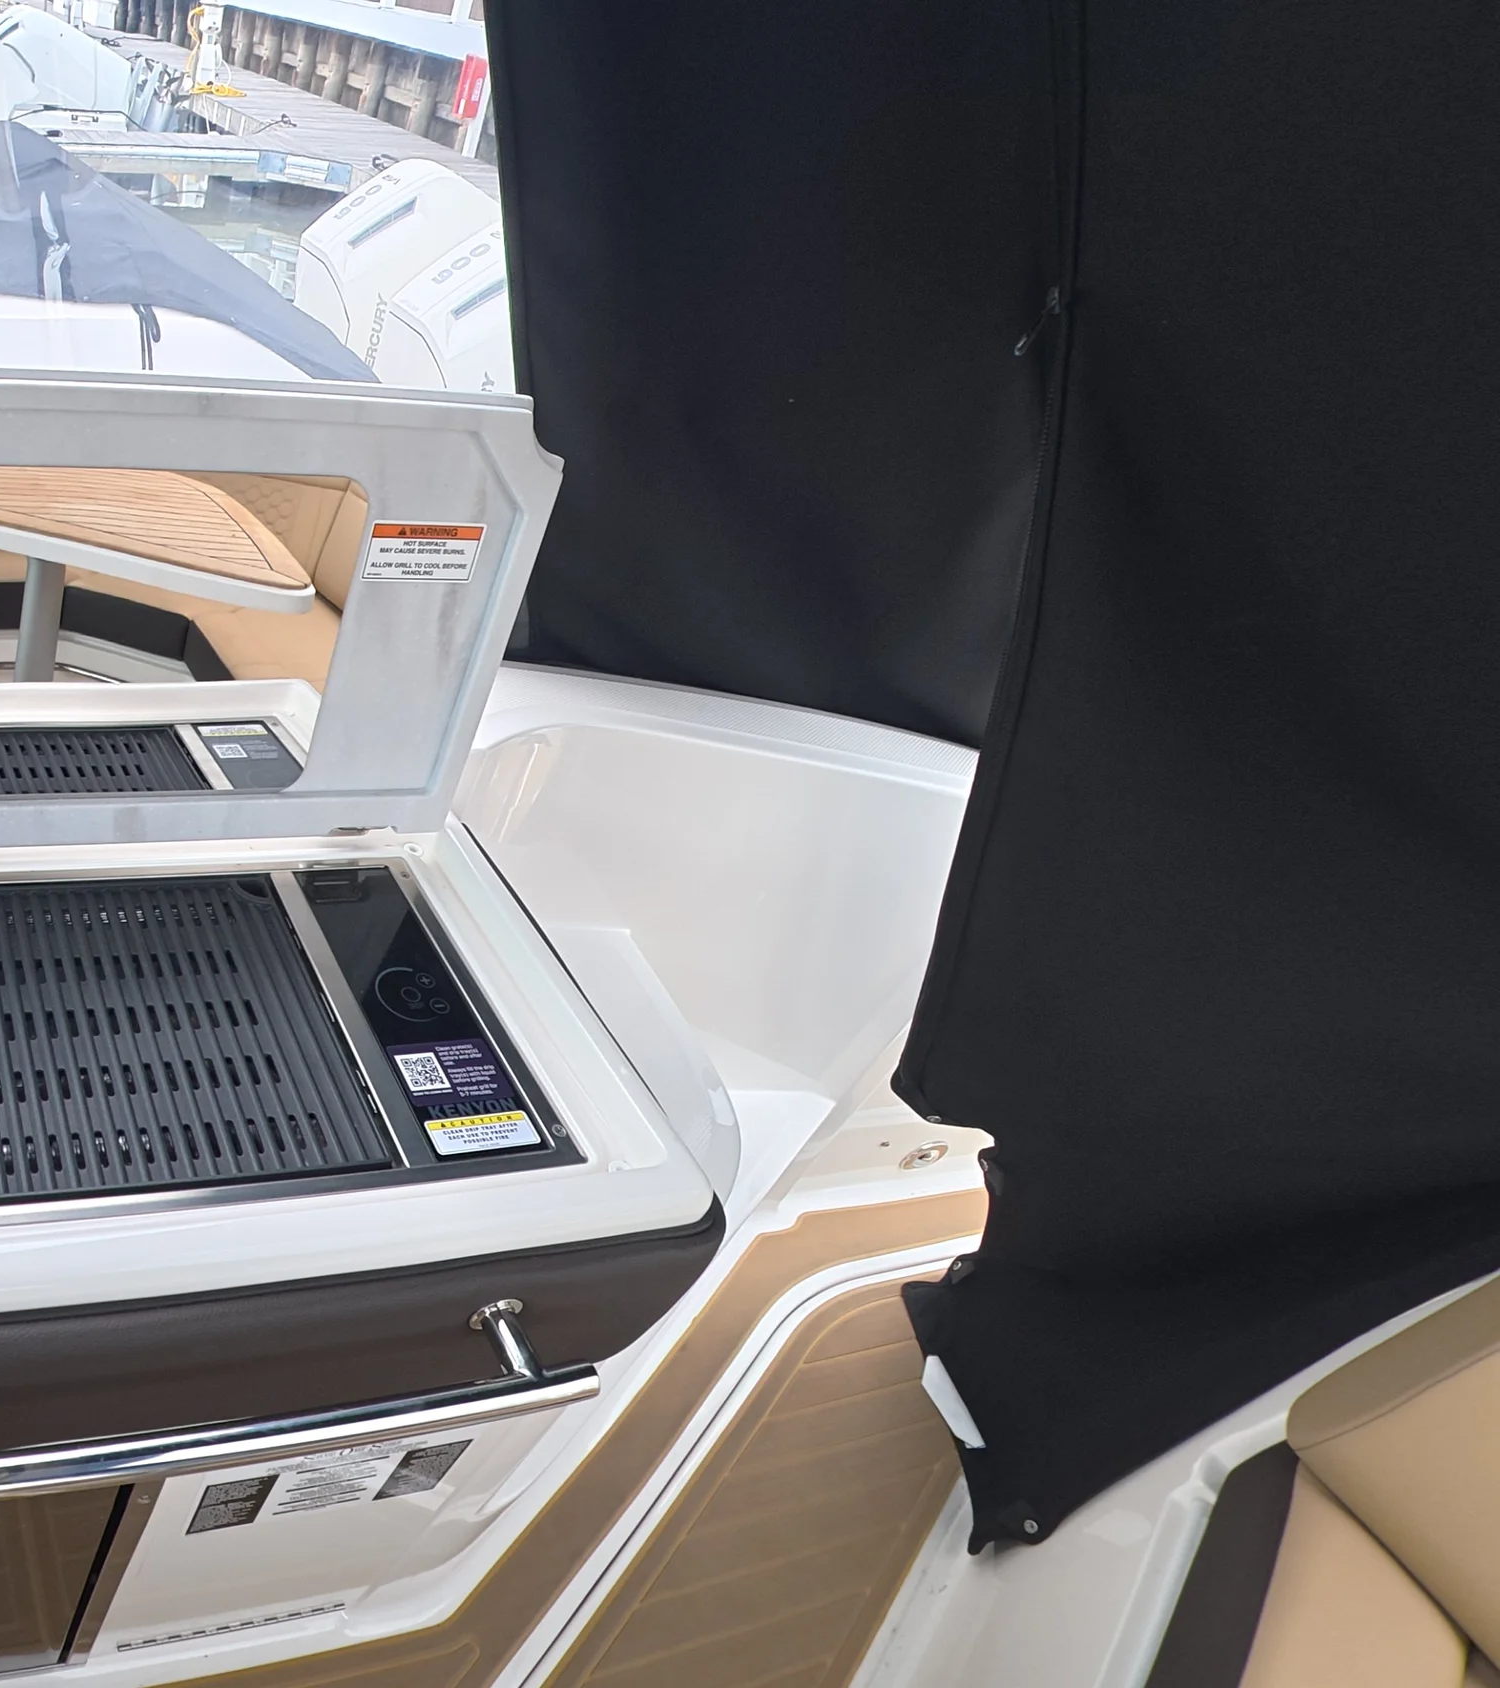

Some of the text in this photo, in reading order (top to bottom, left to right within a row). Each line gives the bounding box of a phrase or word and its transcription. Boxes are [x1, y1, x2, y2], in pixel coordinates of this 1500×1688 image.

[364, 292, 389, 370] ERCURY
[409, 527, 459, 538] WARNING
[417, 540, 448, 548] SURFACE
[394, 547, 416, 555] CAUSE
[370, 561, 394, 569] ALLOW
[427, 1098, 518, 1119] KENYON
[450, 1115, 514, 1128] CAUTION
[490, 1128, 519, 1136] PREVENT
[463, 1137, 494, 1145] POSSIBLE
